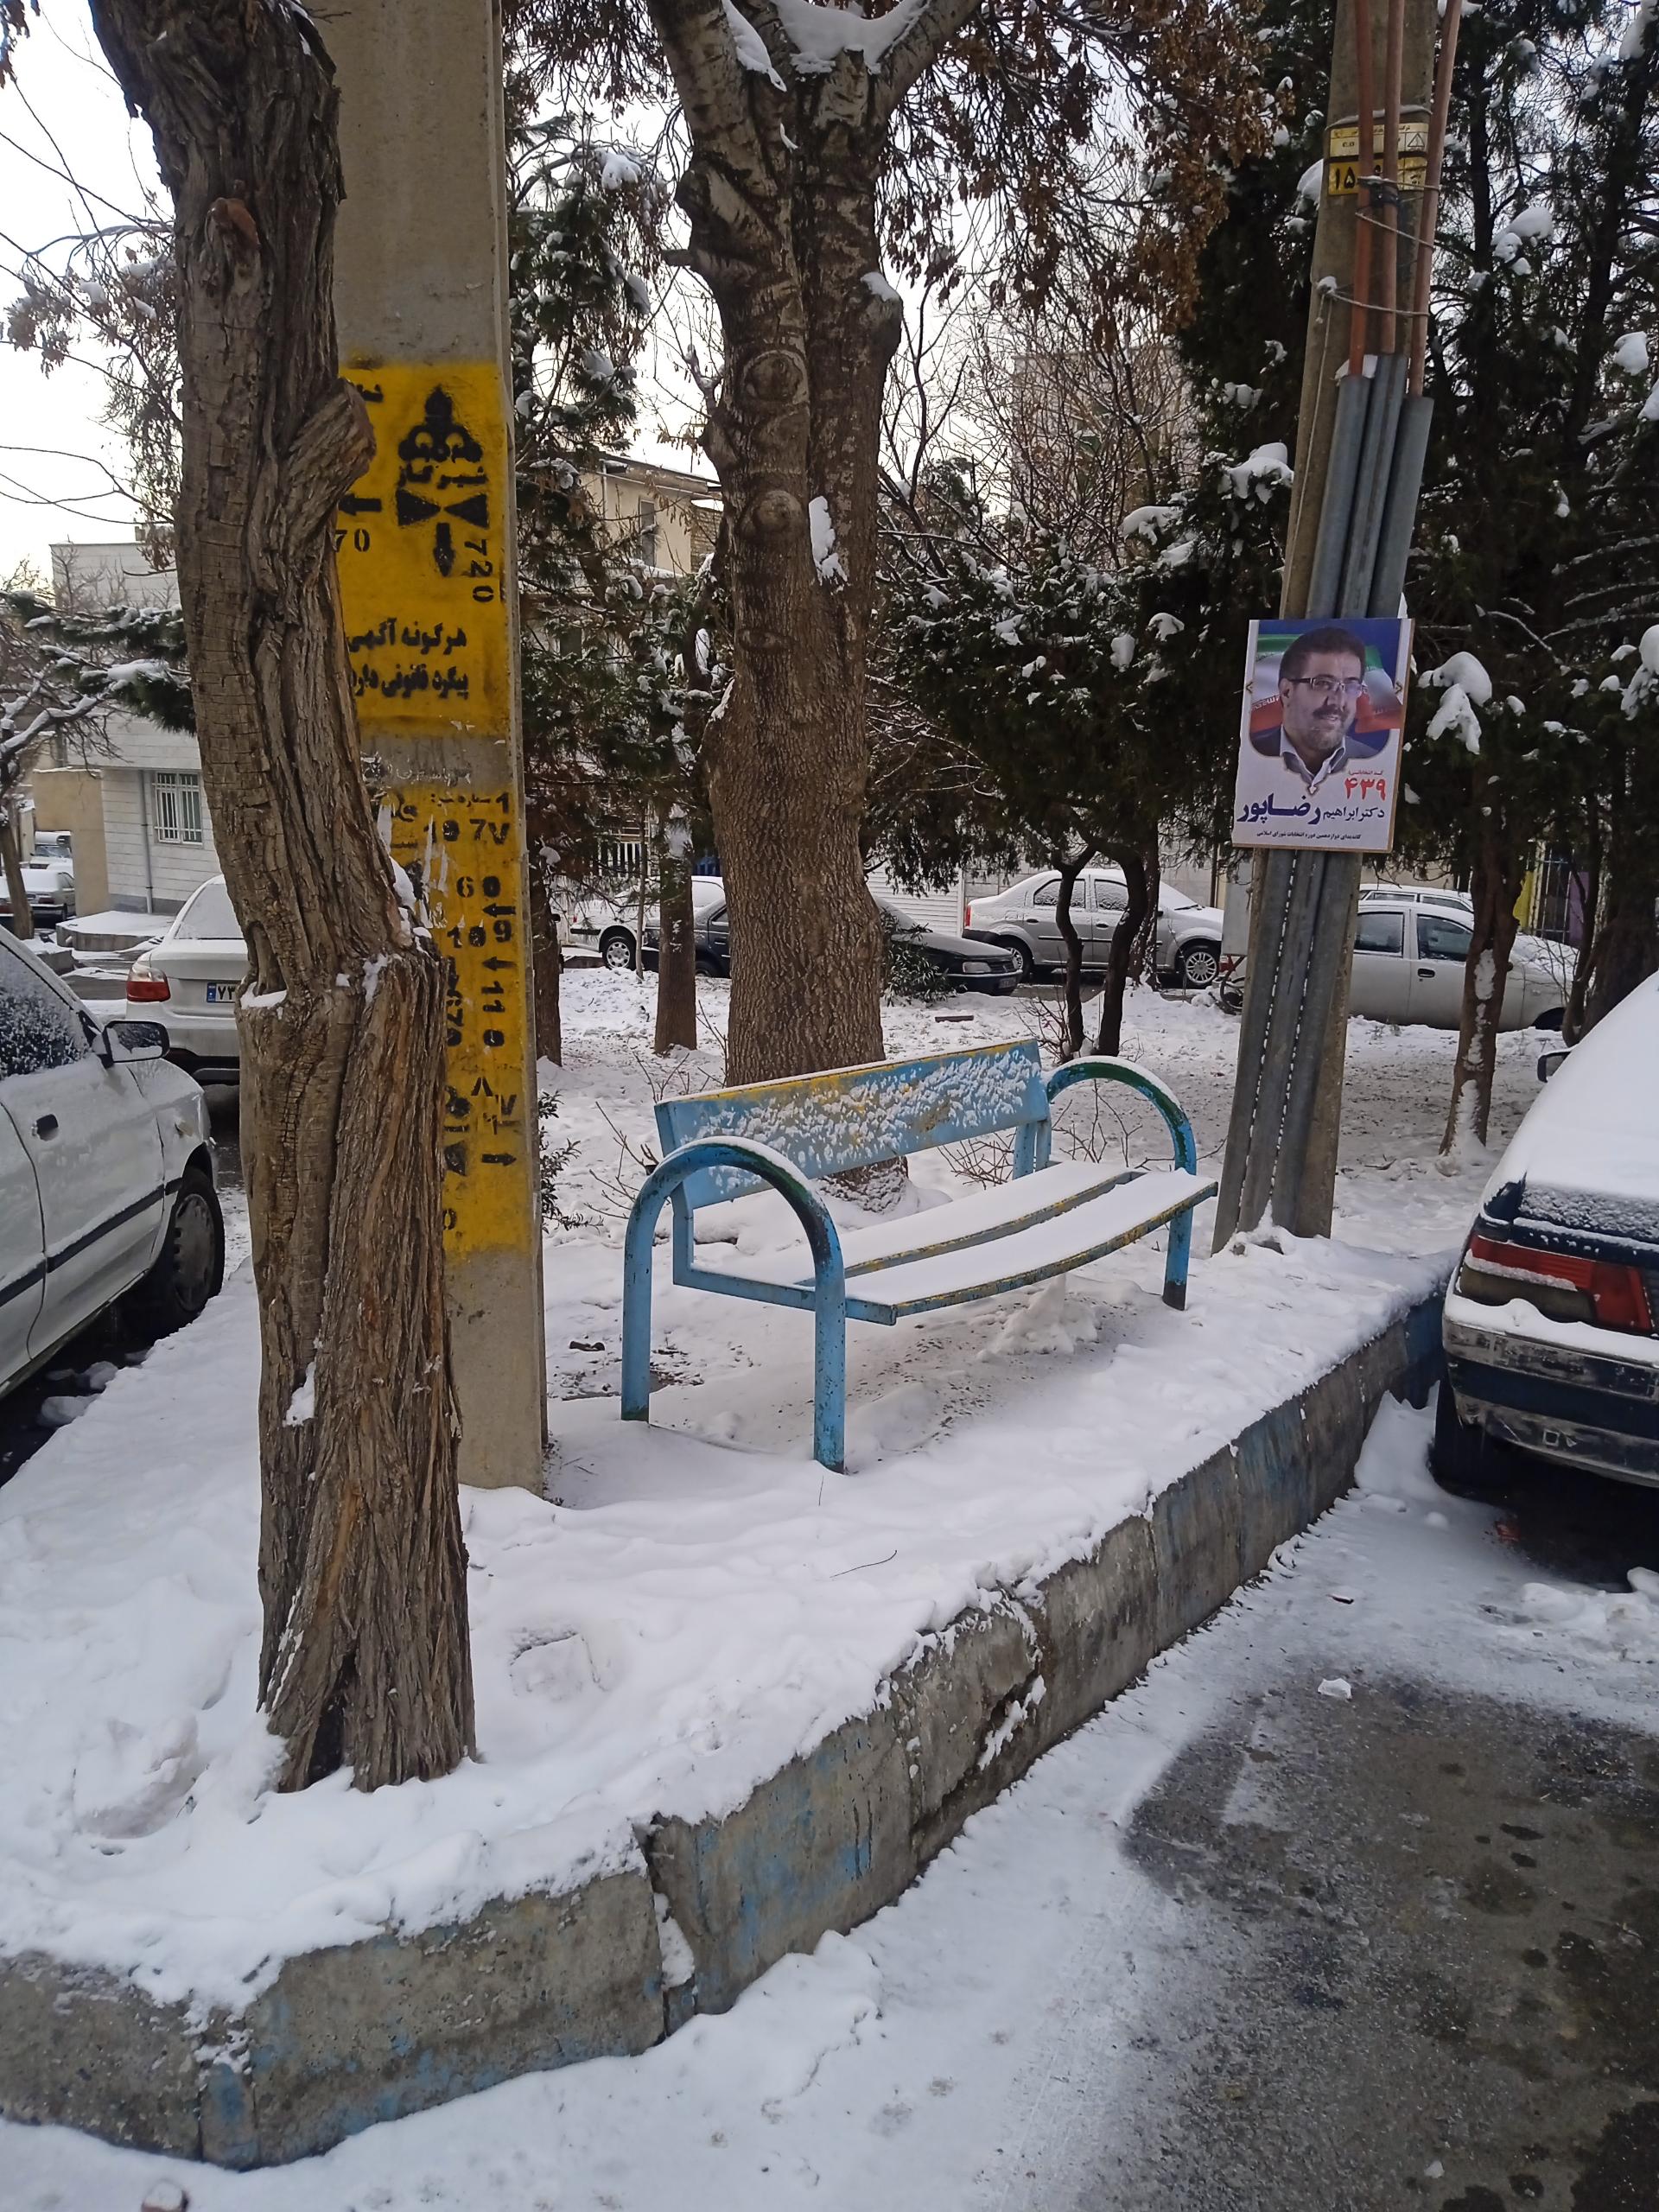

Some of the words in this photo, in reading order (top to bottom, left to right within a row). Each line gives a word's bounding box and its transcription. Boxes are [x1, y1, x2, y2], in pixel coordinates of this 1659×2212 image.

[464, 538, 495, 603] 720
[1344, 777, 1386, 801] ۴۳۹
[1236, 792, 1321, 825] رضاپور
[1322, 806, 1359, 822] ابراهیم
[1357, 806, 1385, 822] دکتر
